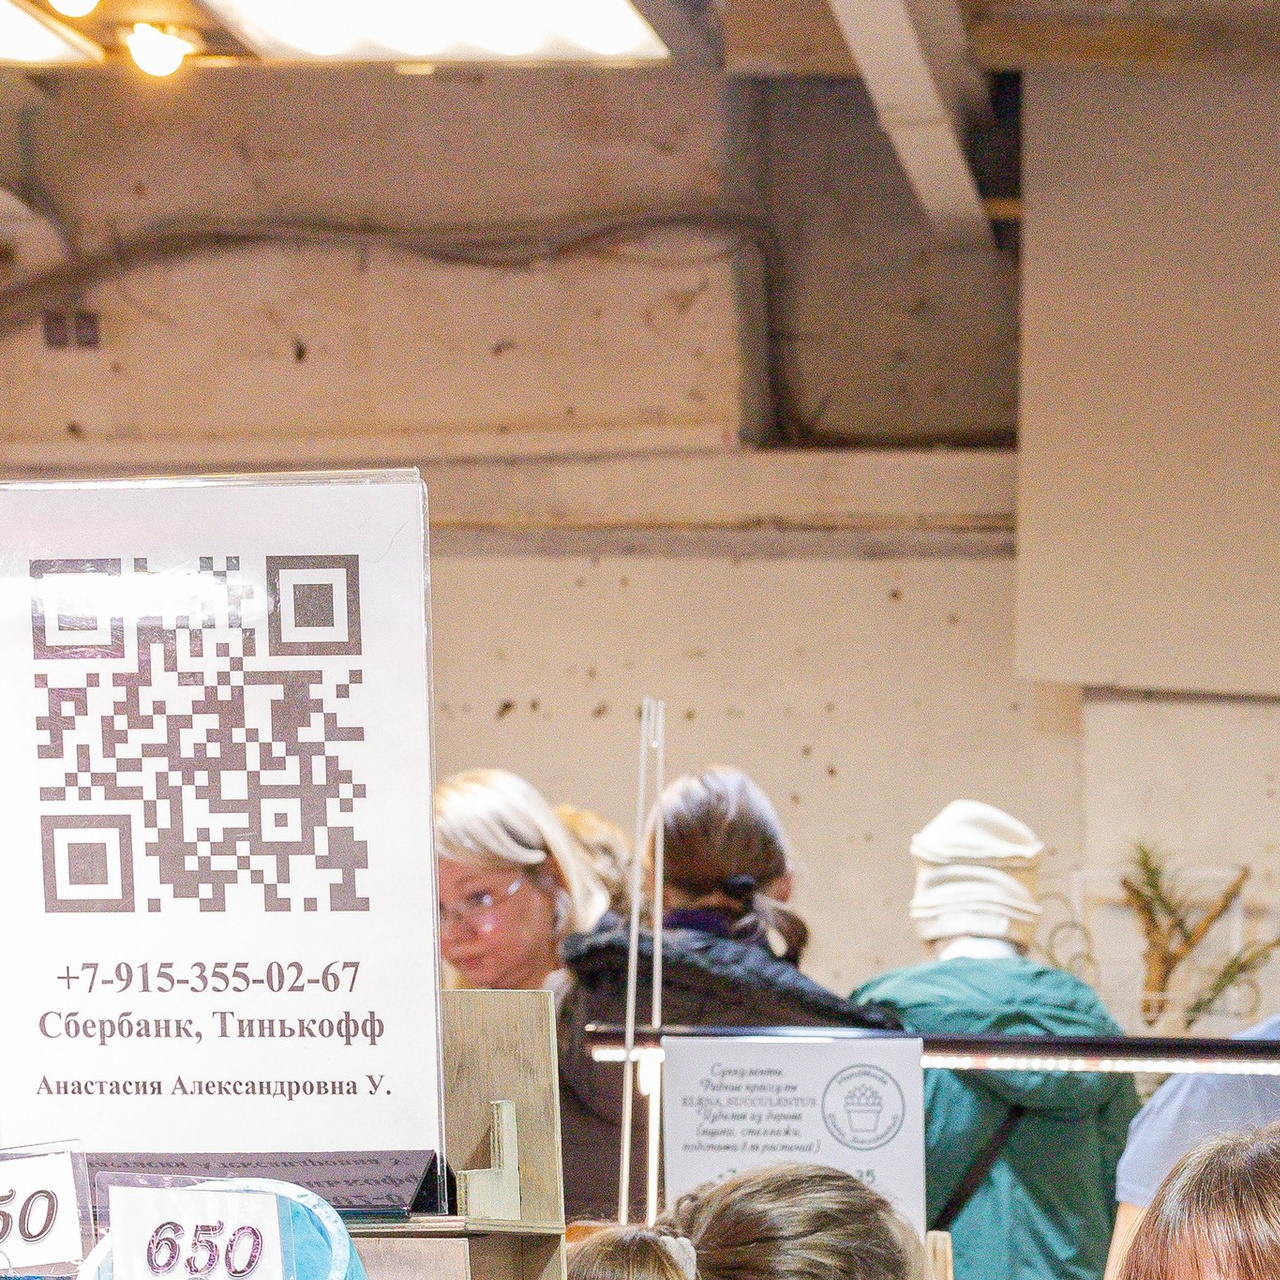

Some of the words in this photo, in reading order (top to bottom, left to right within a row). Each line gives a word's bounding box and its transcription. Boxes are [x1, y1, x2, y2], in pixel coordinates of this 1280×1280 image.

[57, 961, 361, 994] +7-915-355-02-67
[39, 1010, 204, 1046] Сбербанк,
[212, 1010, 385, 1046] Тинькофф
[36, 1076, 163, 1097] Анастасия
[170, 1075, 358, 1101] Александровна
[365, 1075, 392, 1097] У.
[147, 1220, 263, 1280] 650
